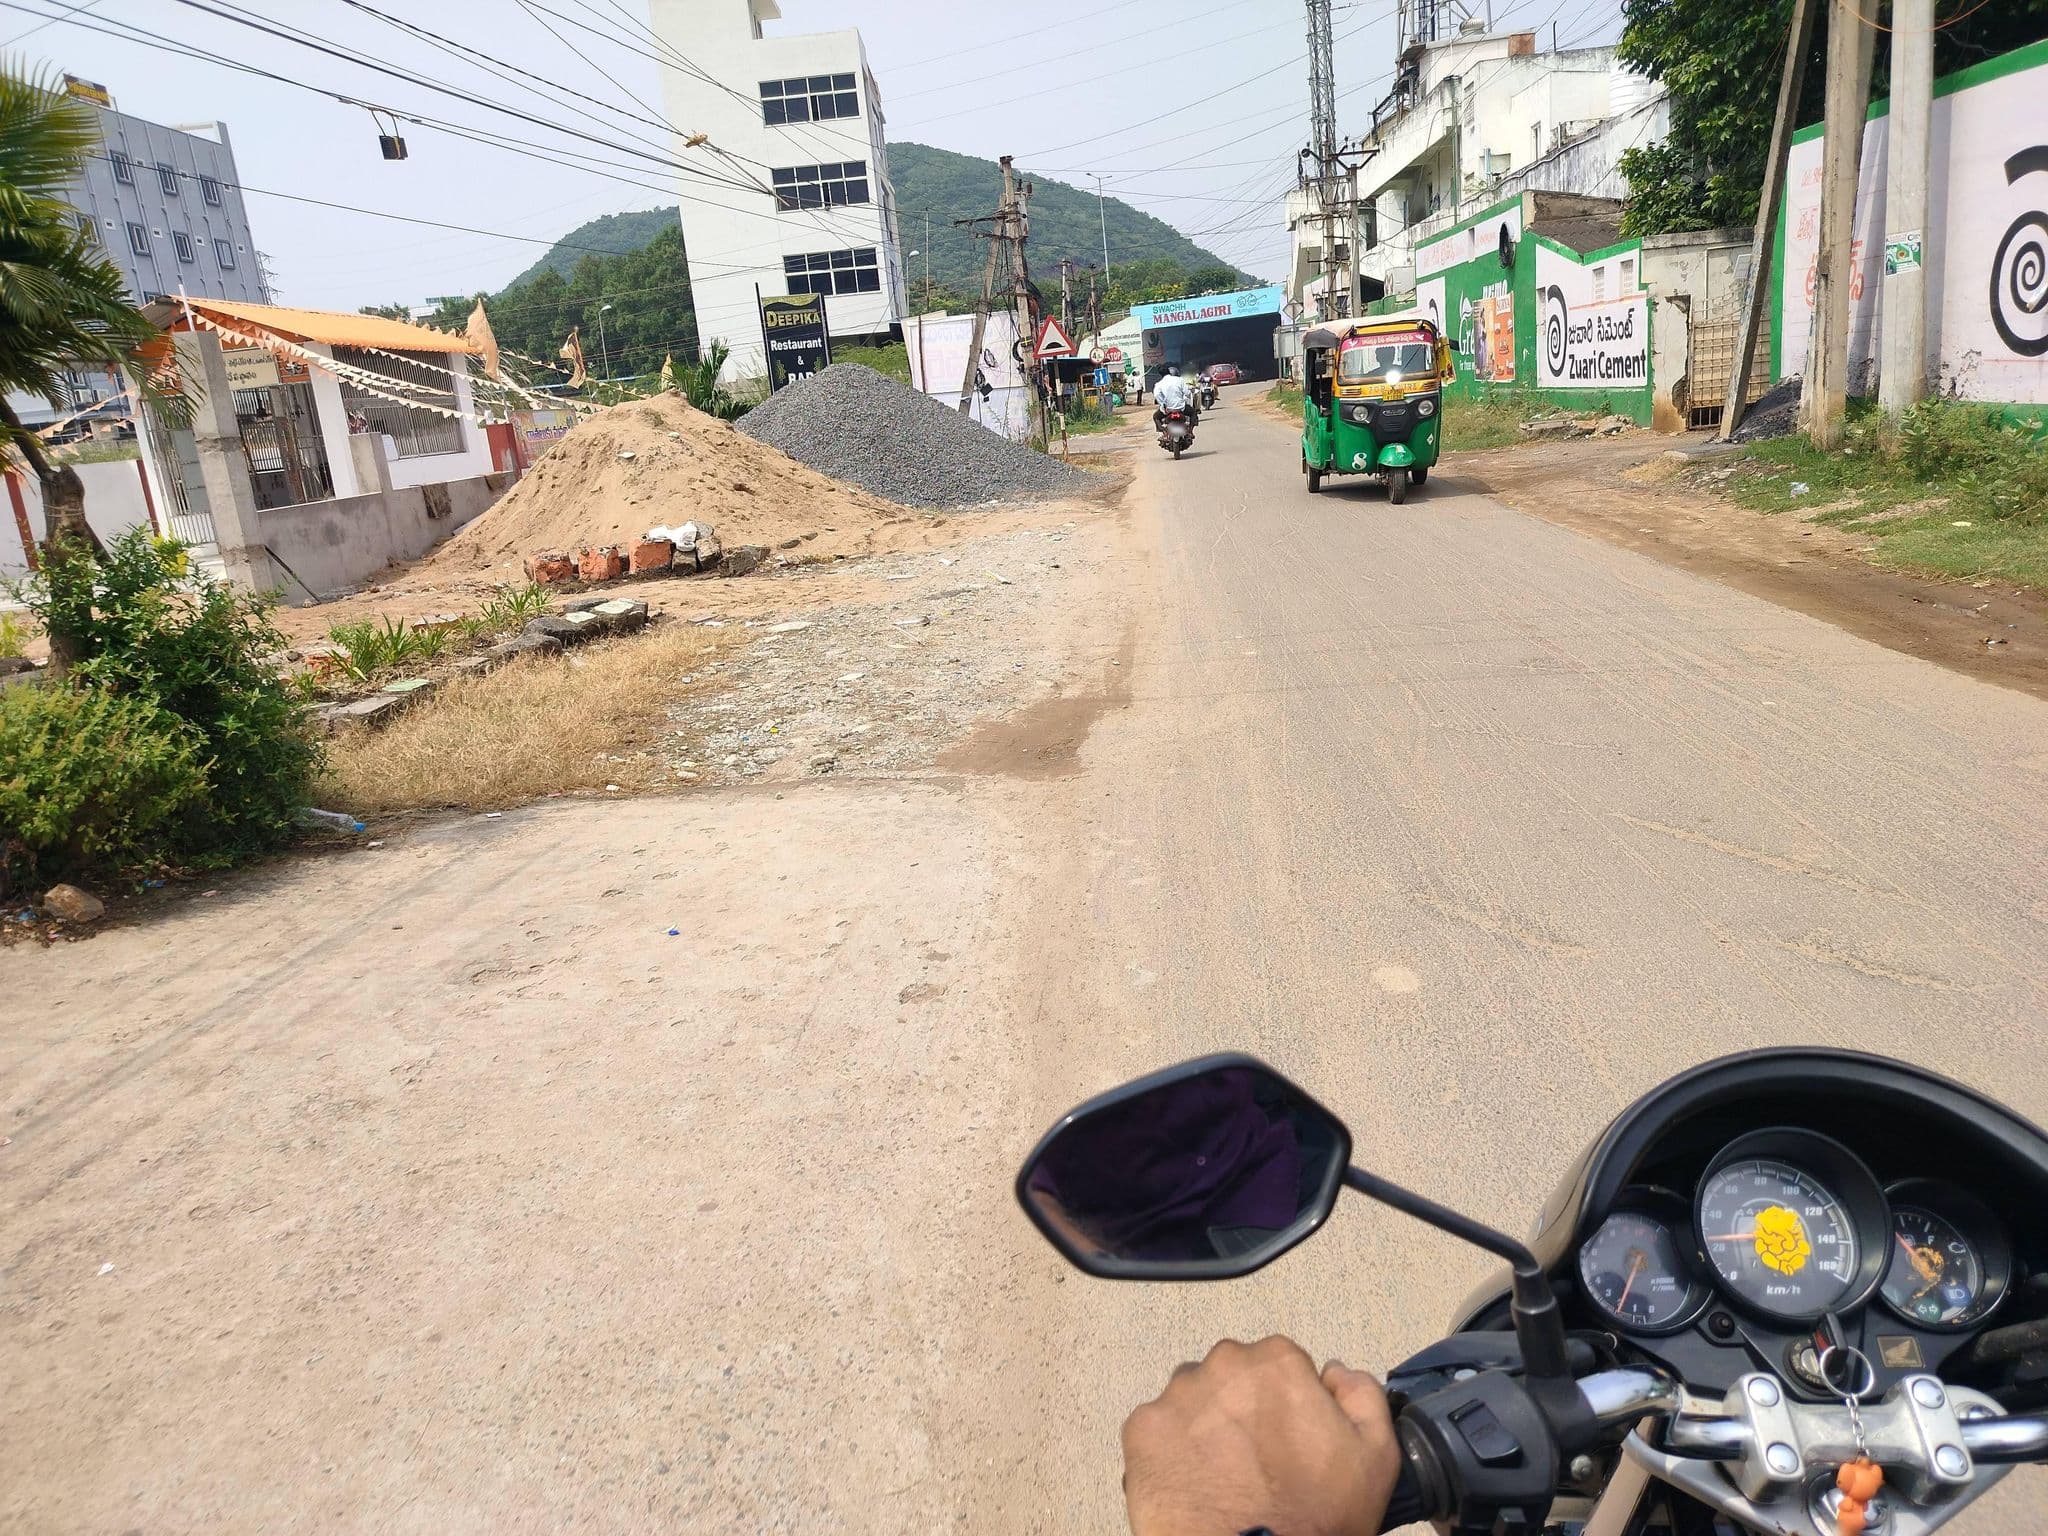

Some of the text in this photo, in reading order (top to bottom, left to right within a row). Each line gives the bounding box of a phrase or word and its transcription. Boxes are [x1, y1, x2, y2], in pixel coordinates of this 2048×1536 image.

[1152, 303, 1186, 314] SWACHH
[766, 310, 821, 327] DEEPIKA
[1153, 304, 1232, 325] MANGALAGIRI
[1568, 307, 1635, 345] జువారి సిమెంట్
[770, 337, 822, 351] Restaurant
[797, 355, 805, 366] &
[1569, 348, 1646, 379] Zuari Cement
[1782, 1186, 1800, 1195] 100
[1709, 1210, 1722, 1219] 40
[1805, 1206, 1823, 1216] 120
[1817, 1234, 1836, 1244] 140
[1712, 1243, 1725, 1252] 20
[1819, 1261, 1837, 1271] 160
[1730, 1271, 1738, 1281] 0
[1605, 1288, 1612, 1297] 3
[1766, 1285, 1801, 1296] km/h
